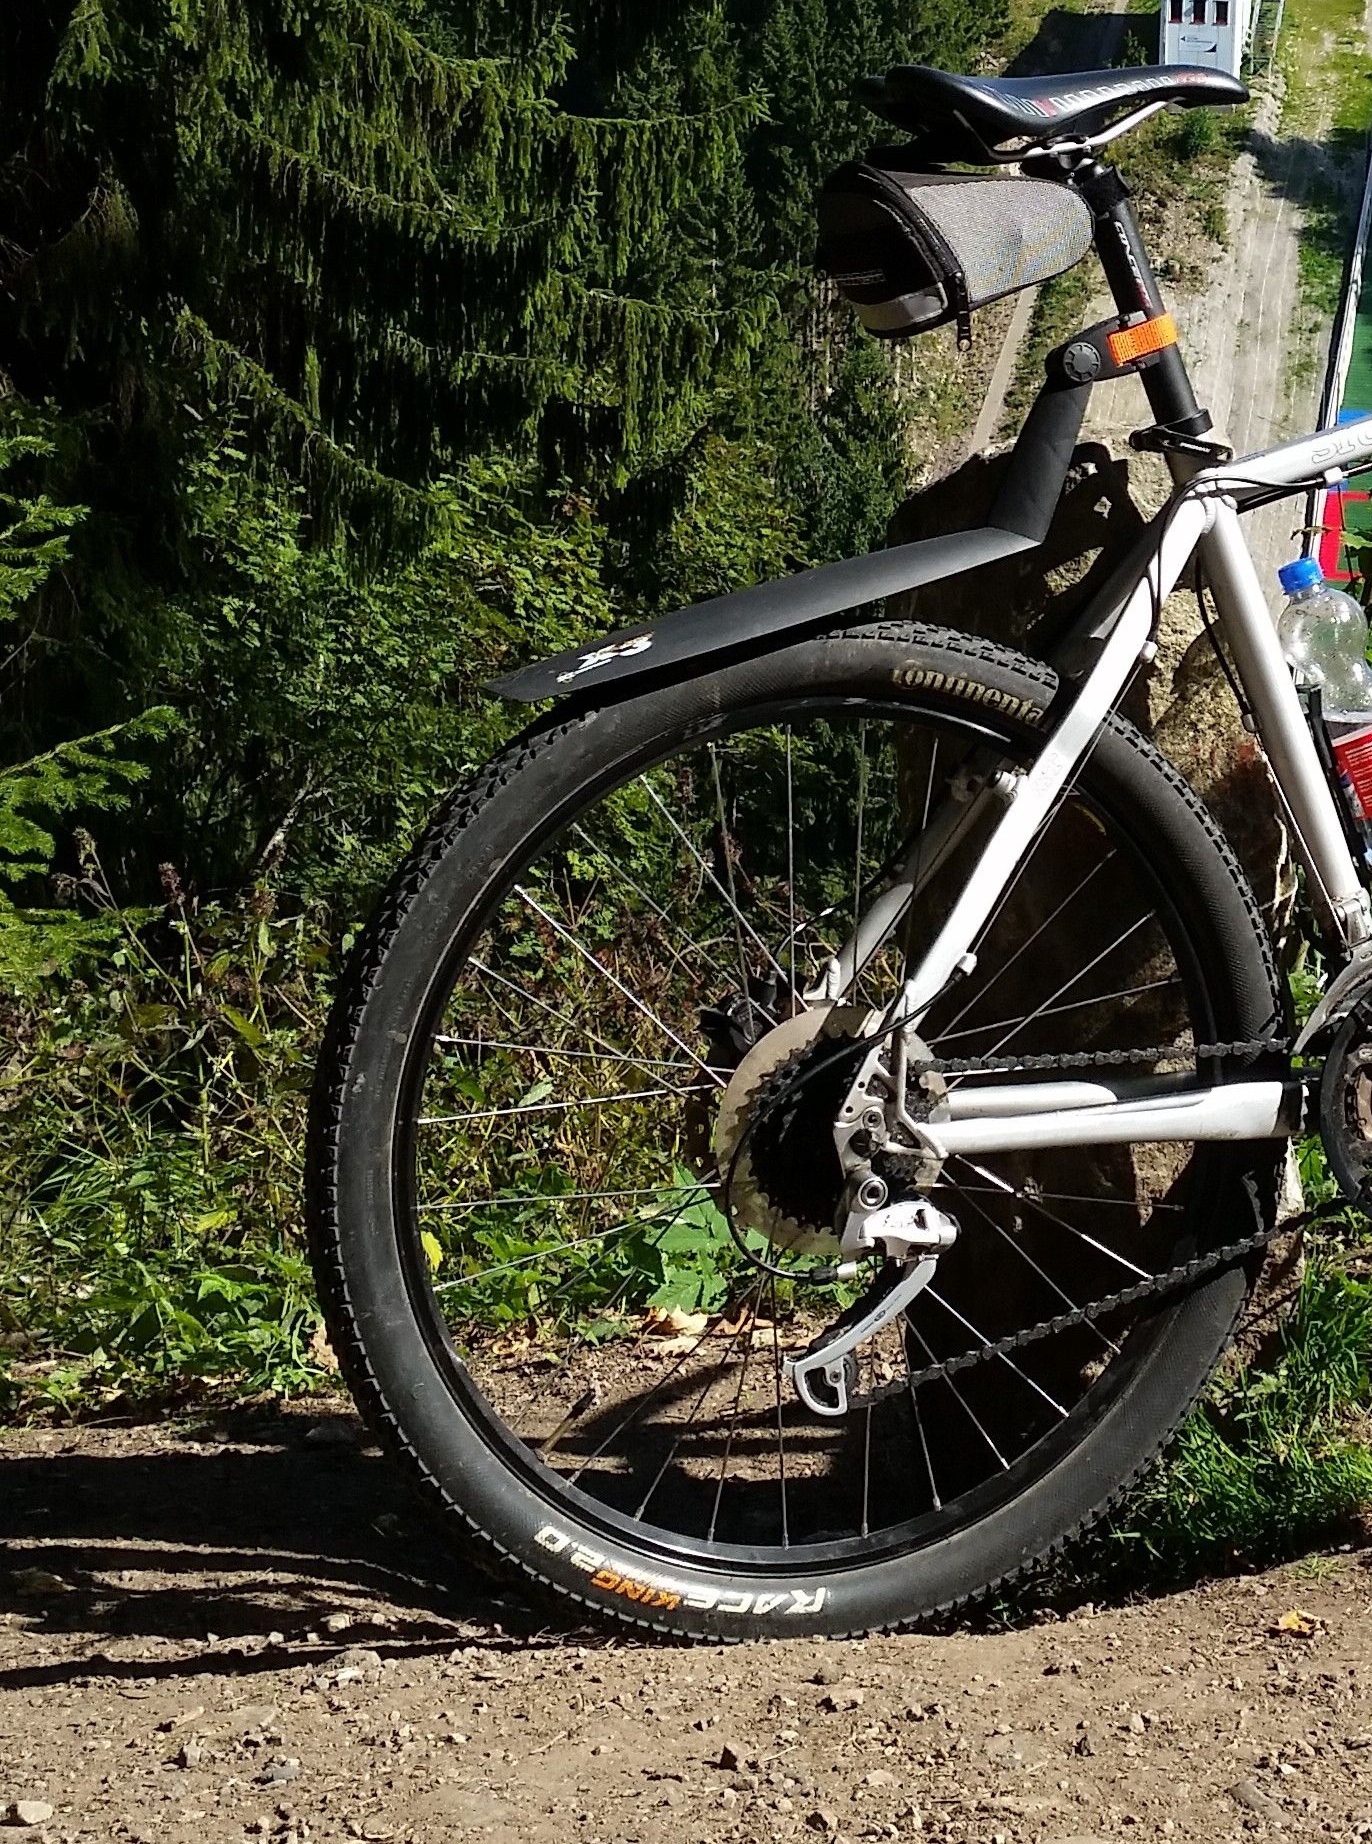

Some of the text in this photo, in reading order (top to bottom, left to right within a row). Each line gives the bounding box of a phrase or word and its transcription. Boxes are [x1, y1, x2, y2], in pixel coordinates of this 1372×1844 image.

[533, 1525, 827, 1615] RACE KING 2.0
